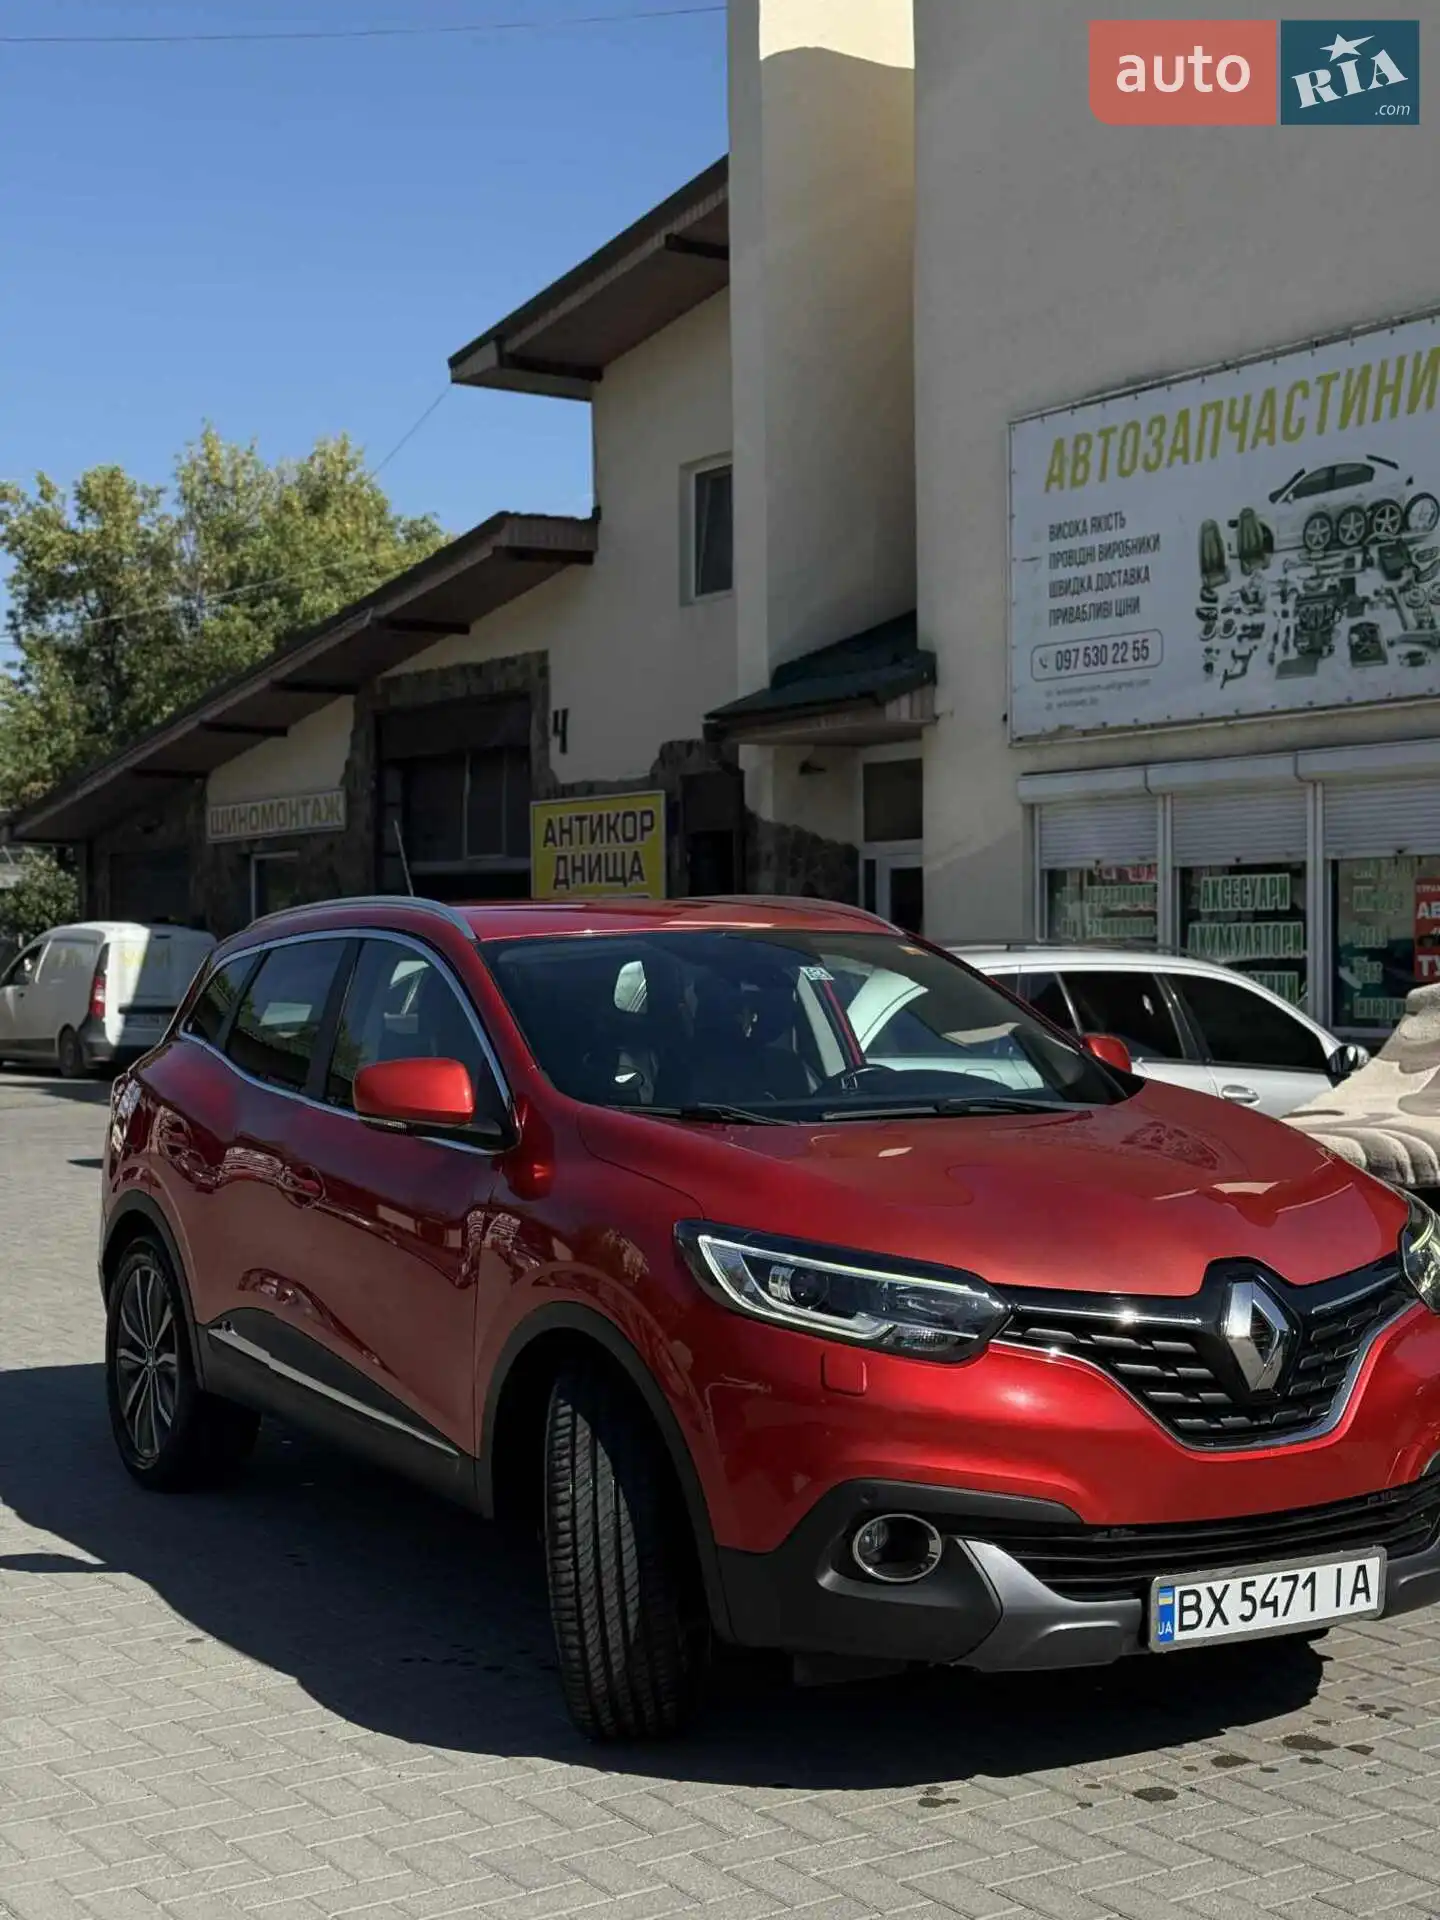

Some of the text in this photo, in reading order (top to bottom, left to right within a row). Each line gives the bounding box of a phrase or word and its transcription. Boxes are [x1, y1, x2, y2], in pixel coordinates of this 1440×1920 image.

[1044, 346, 1440, 493] АВТОЗАПЧАСТИНИ
[1048, 510, 1127, 542] ВИСОКА ЯКІСТЬ
[1048, 533, 1161, 569] ПРОВІДНІ ВИРОБНИКИ
[1048, 565, 1151, 599] ШВИДКА ДОСТАВКА
[1048, 595, 1141, 628] ПРИВАБЛИВІ ЦІНИ
[1055, 647, 1080, 671] 097
[1112, 640, 1128, 664] 22
[1132, 638, 1150, 662] 55
[210, 792, 342, 834] ШИНОМОНТАЖ
[543, 809, 655, 848] АНТИКОР
[553, 850, 646, 890] ДНИЩА
[1201, 875, 1290, 911] АКСЕСУАРИ
[1188, 923, 1303, 958] АКУМУЛЯТОРИ
[1178, 1564, 1372, 1632] BX 5471 IA
[1158, 1624, 1173, 1636] UA
